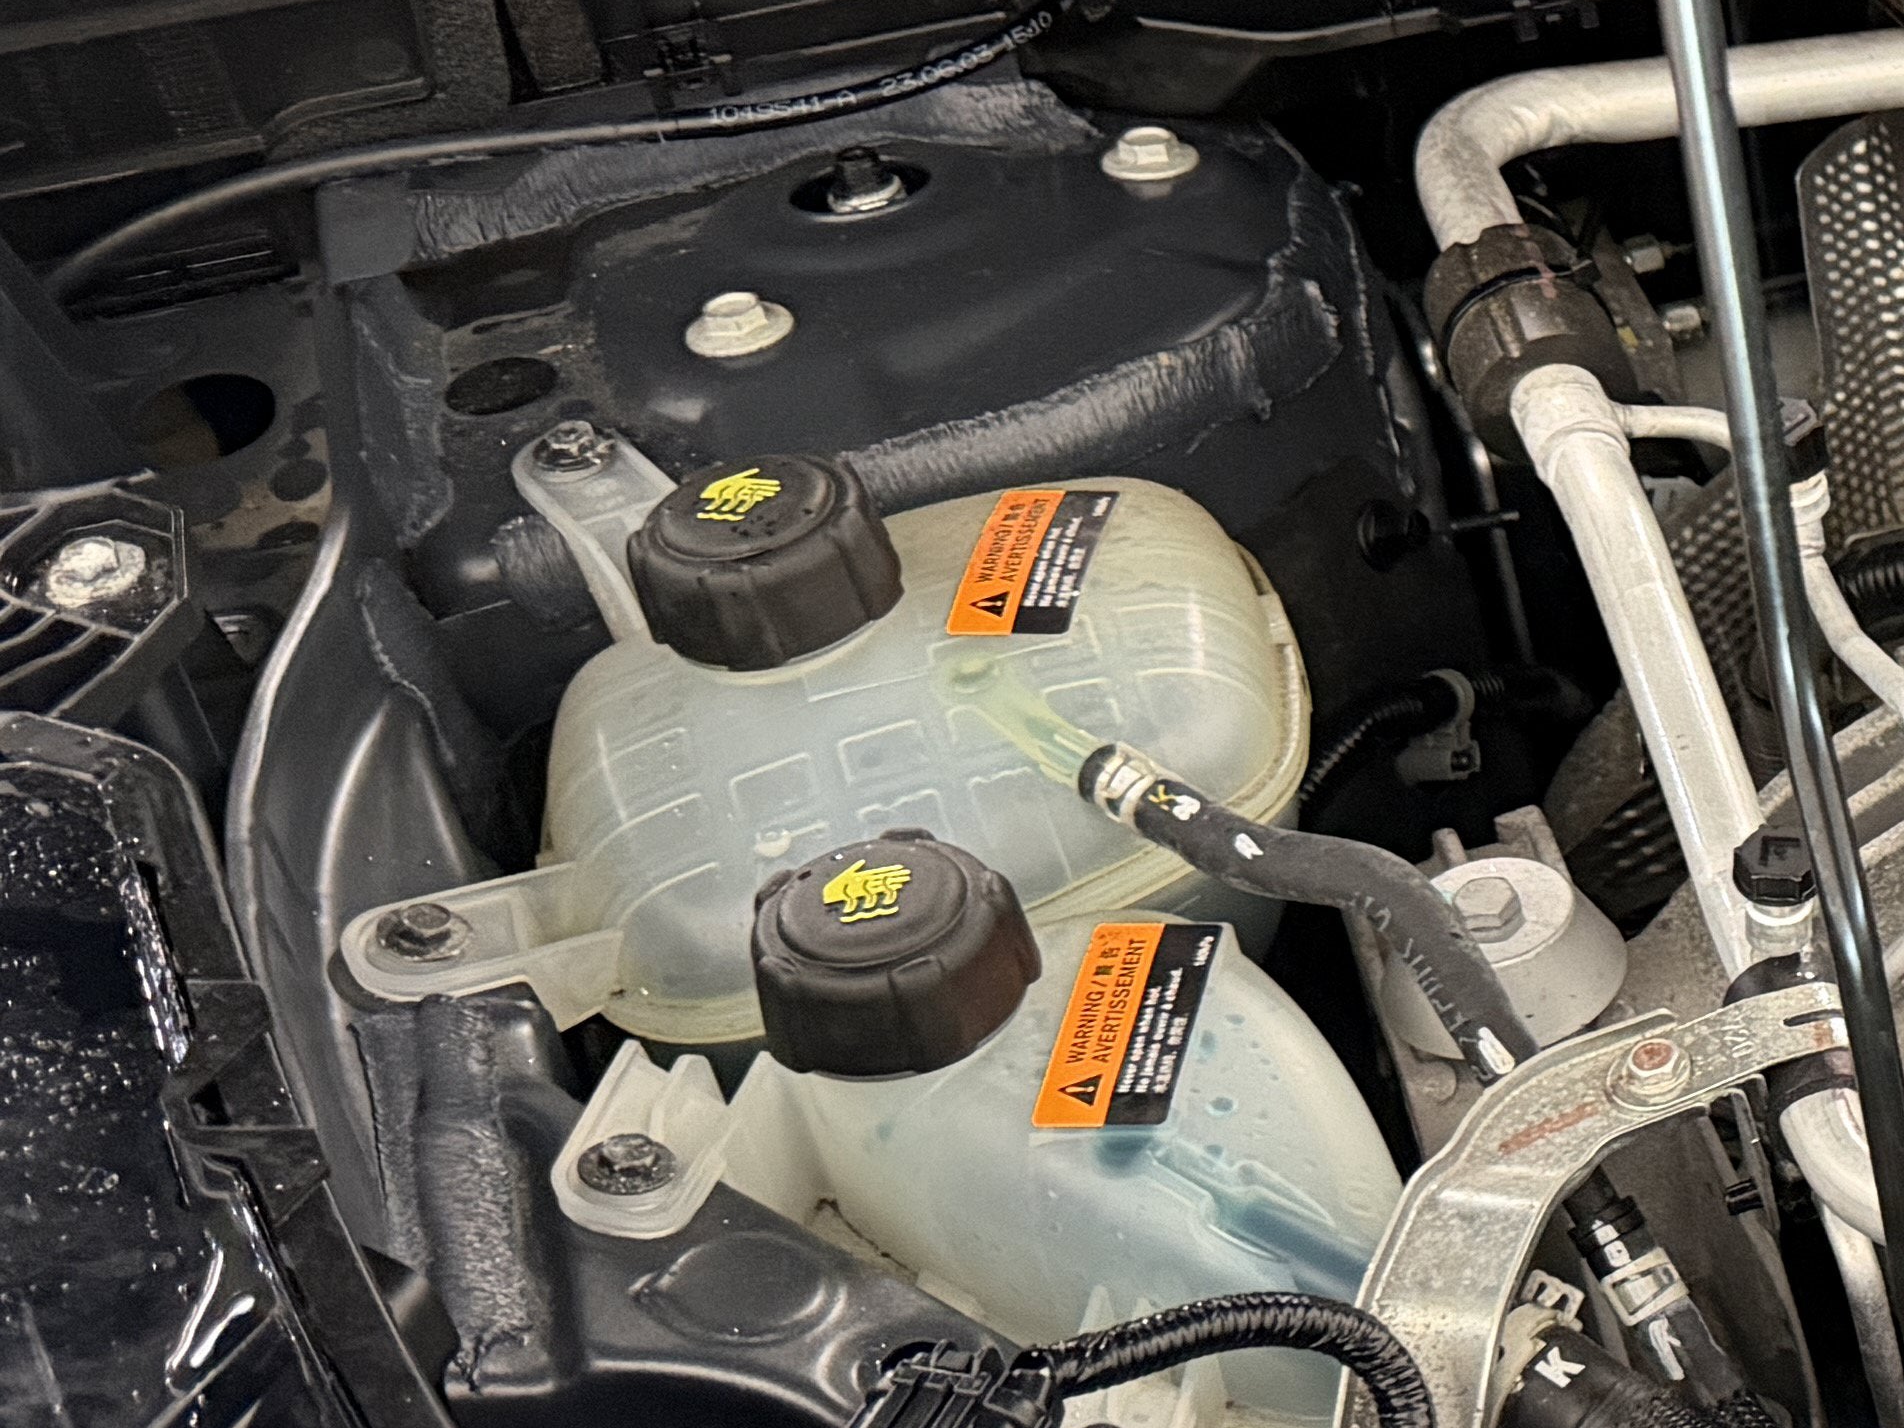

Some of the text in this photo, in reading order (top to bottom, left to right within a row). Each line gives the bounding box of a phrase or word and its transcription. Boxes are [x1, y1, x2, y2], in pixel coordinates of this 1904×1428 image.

[1065, 991, 1106, 1064] WARNING
[1091, 938, 1147, 1063] AVERTISSEMENT
[1534, 1346, 1585, 1388] K
